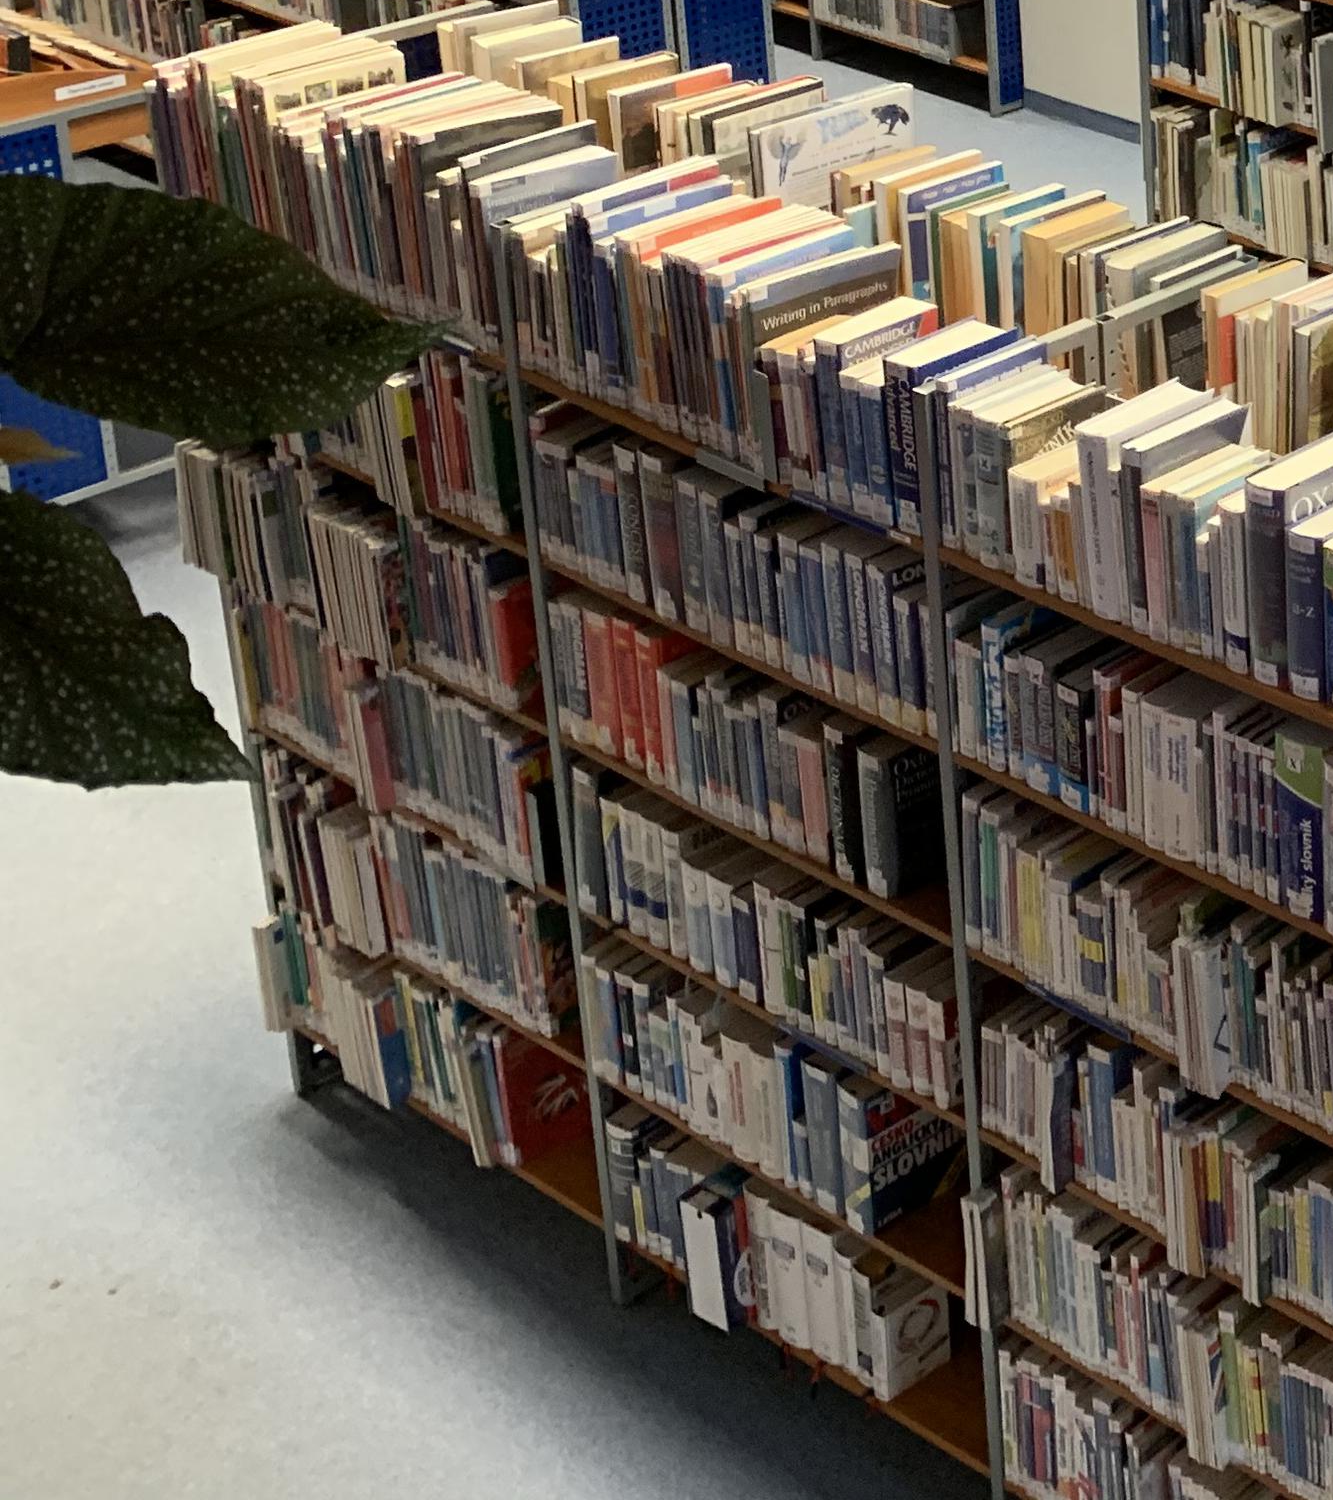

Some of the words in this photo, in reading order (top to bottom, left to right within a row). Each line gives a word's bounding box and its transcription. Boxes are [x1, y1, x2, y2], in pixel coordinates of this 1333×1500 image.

[763, 306, 806, 331] Writing
[809, 302, 821, 314] in
[823, 282, 888, 309] Paragraphs
[844, 320, 916, 359] CAMBRIDGE
[898, 375, 917, 471] CAMBRIDGE
[853, 570, 868, 654] ONGMAN
[877, 579, 892, 665] ONGMAN
[1300, 818, 1313, 871] slovník
[872, 1126, 962, 1192] SLOVNÍ
